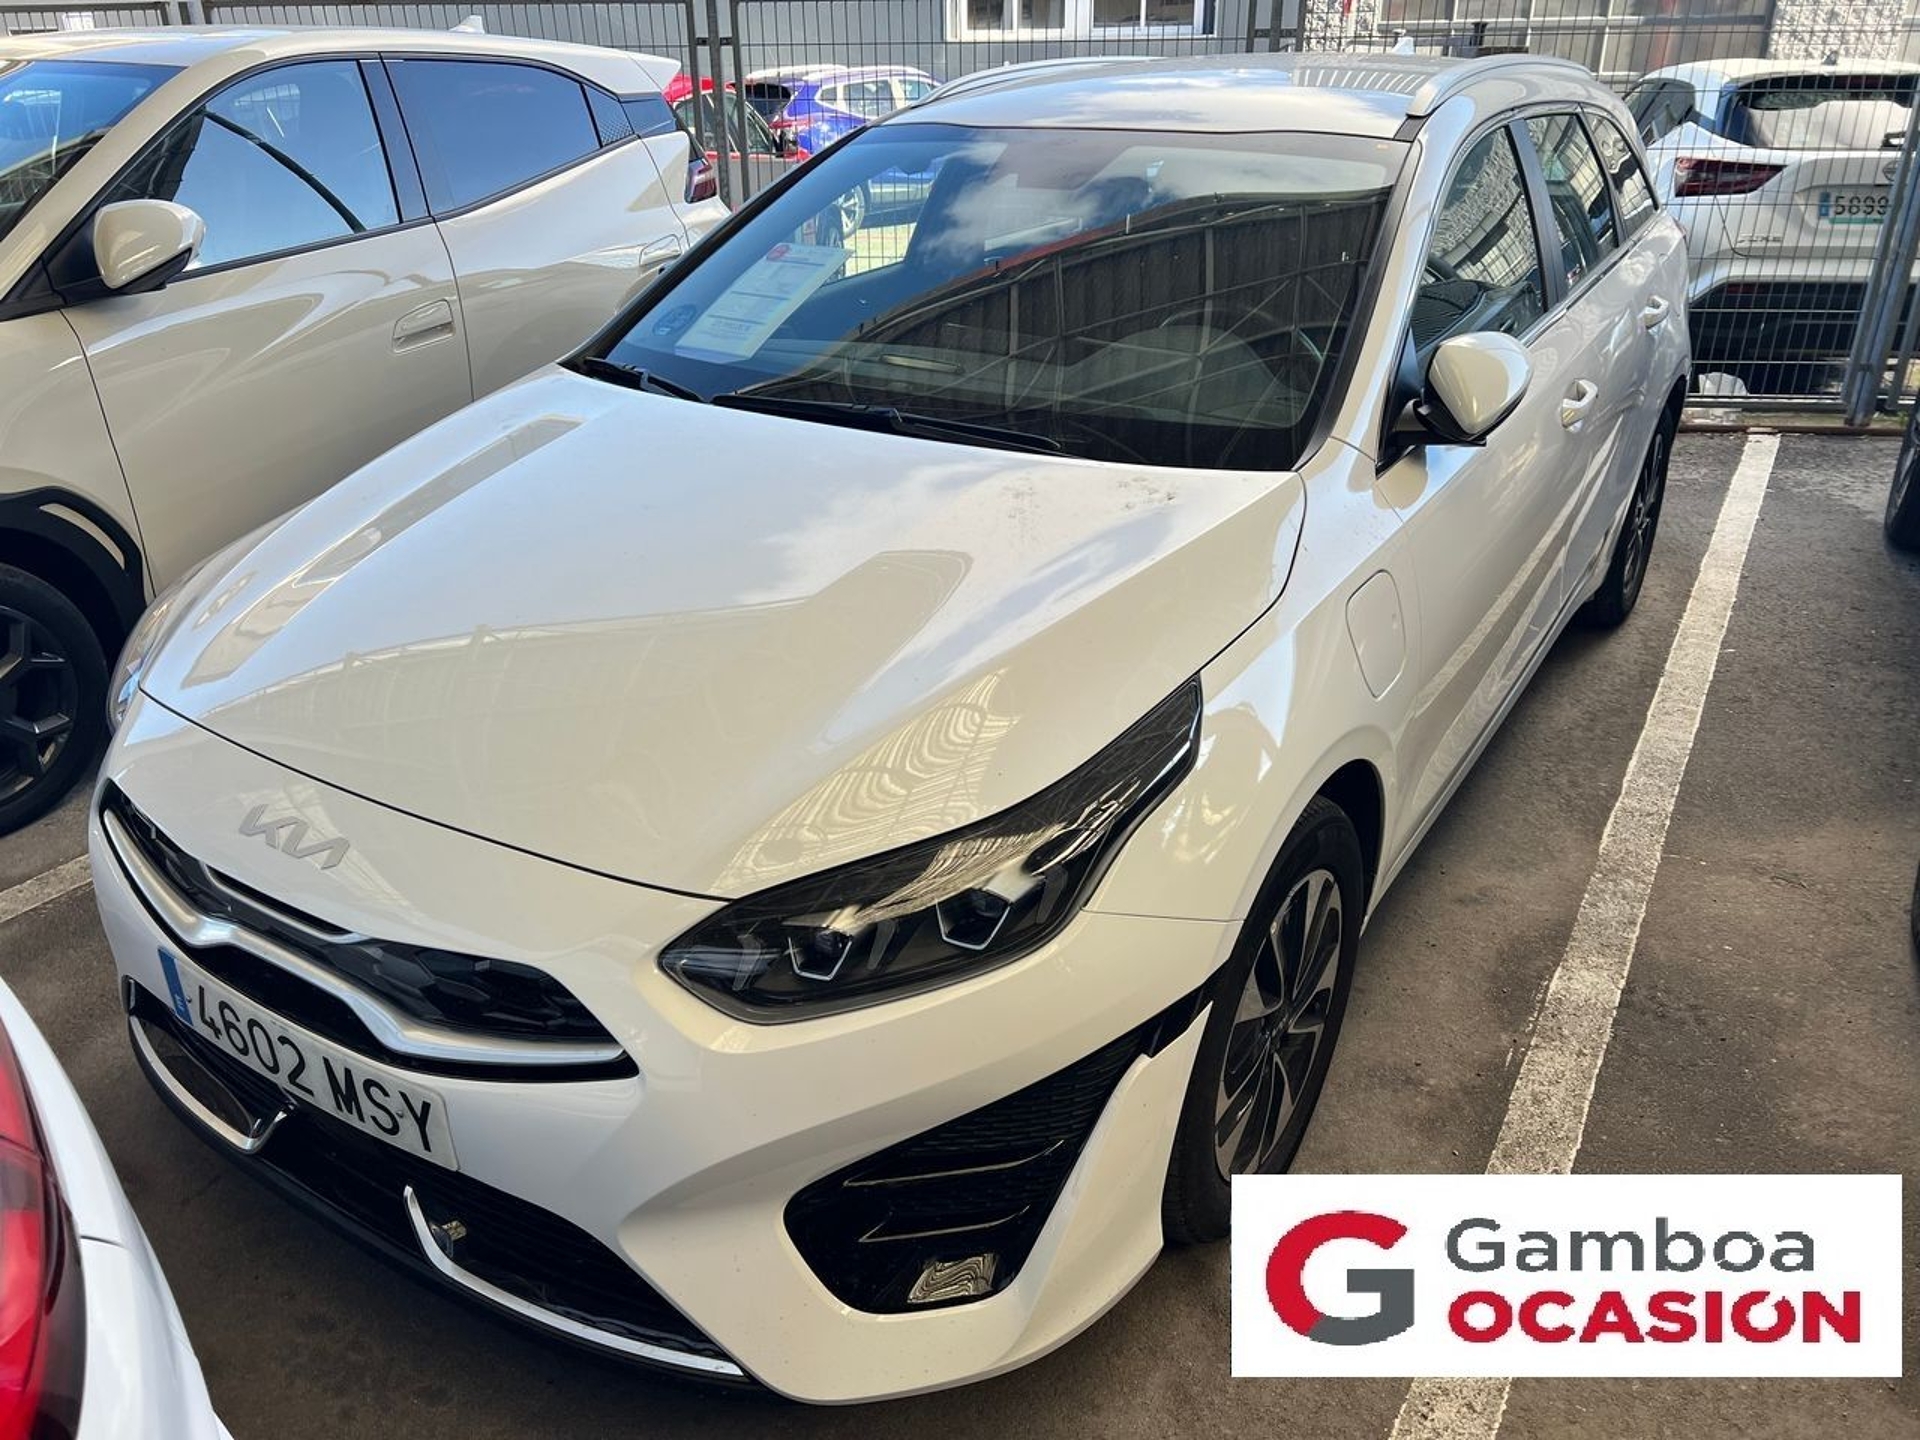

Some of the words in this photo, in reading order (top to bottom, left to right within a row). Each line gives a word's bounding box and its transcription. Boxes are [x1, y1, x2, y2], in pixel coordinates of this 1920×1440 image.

[238, 803, 350, 870] KIA
[198, 984, 315, 1098] 4602
[322, 1056, 432, 1153] MSY
